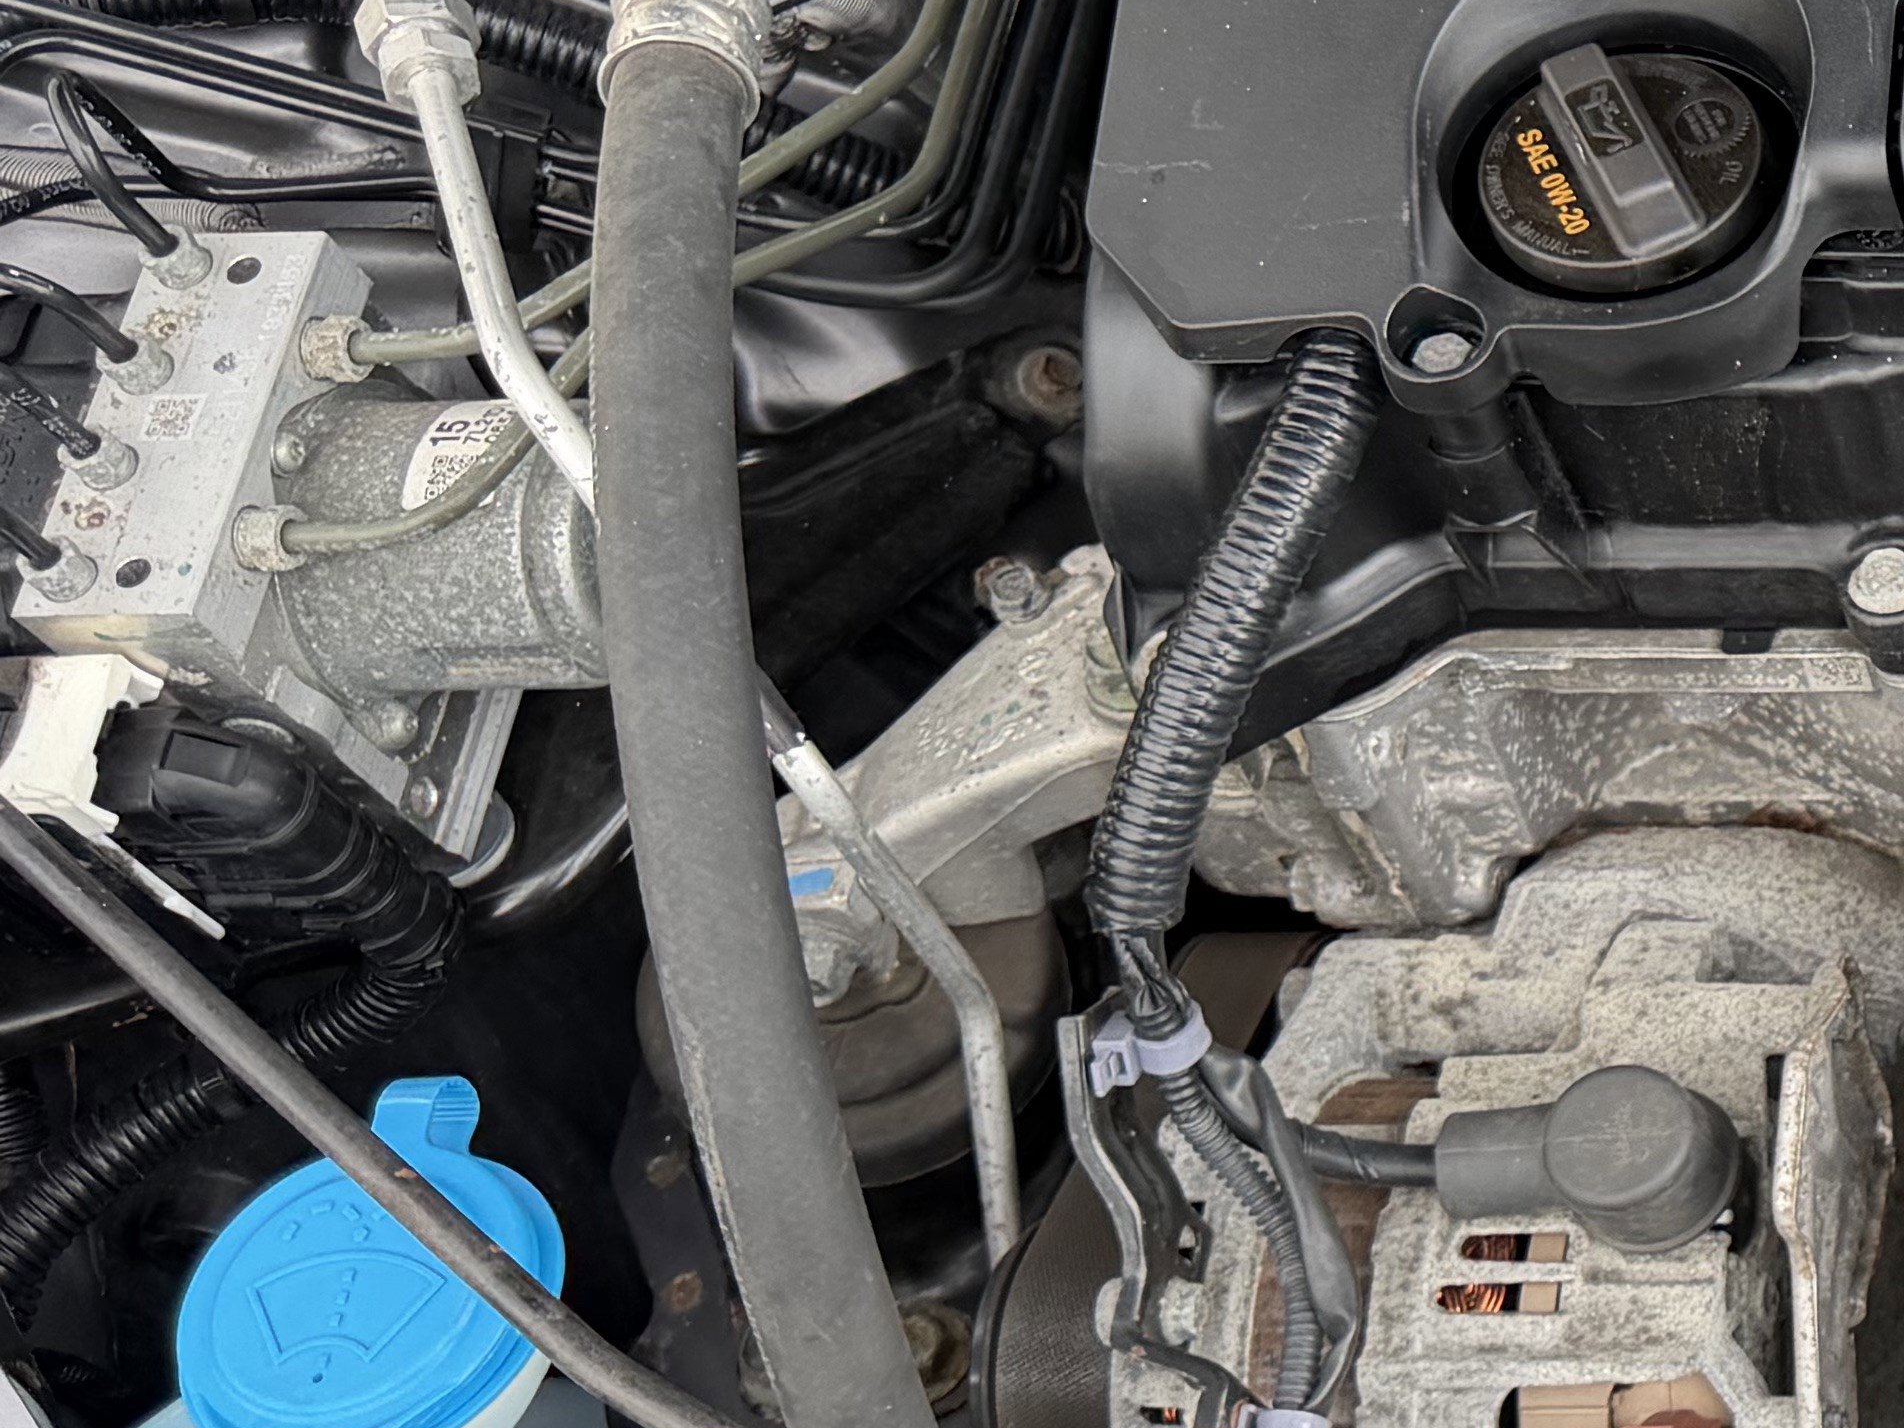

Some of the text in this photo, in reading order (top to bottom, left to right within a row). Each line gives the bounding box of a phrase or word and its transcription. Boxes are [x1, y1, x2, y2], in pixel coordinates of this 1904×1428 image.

[1516, 128, 1590, 236] SAE 0W-20
[1718, 160, 1744, 186] OIL
[1510, 219, 1571, 256] MANUAL
[429, 419, 471, 447] 15
